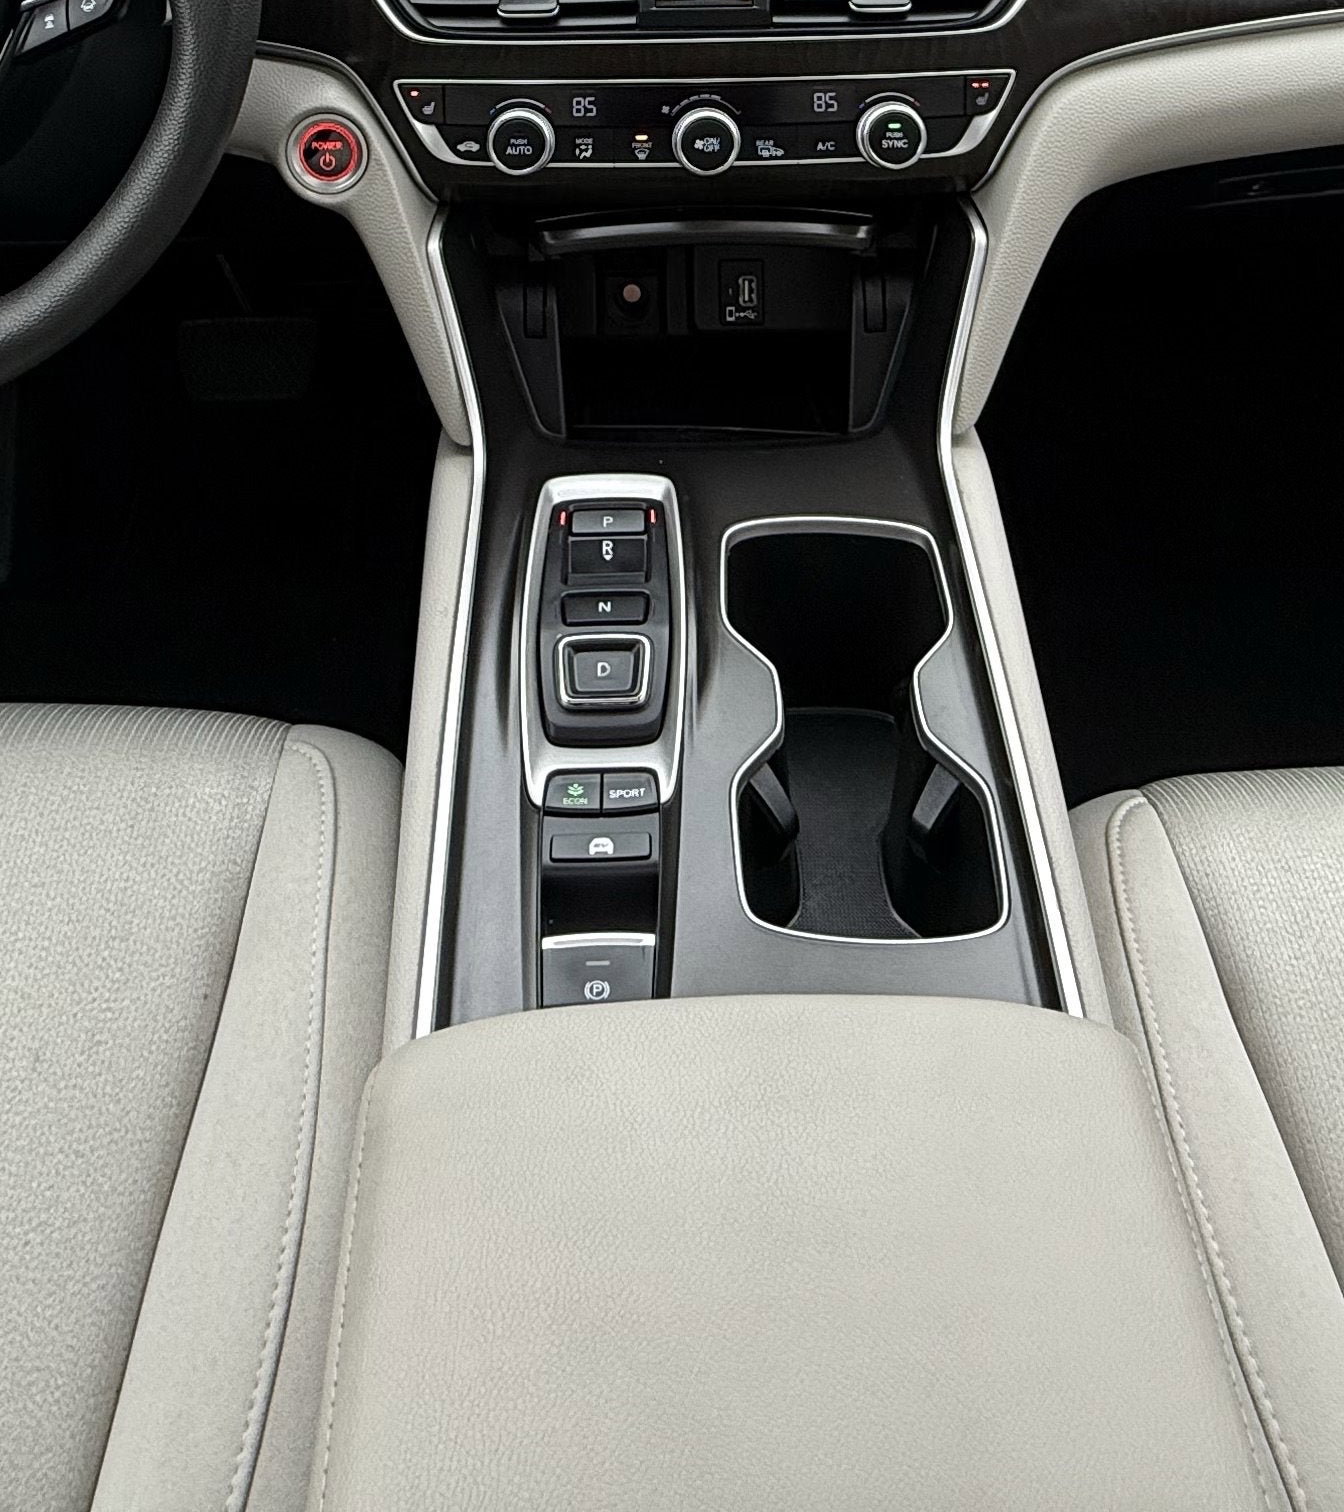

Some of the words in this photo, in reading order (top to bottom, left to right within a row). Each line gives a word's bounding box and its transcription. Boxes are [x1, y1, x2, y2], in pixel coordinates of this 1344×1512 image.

[572, 96, 597, 117] 85
[813, 92, 838, 113] 85
[816, 141, 836, 151] A/C
[881, 139, 909, 149] SYNC
[506, 146, 533, 155] AUTO
[603, 516, 614, 528] P
[602, 541, 613, 554] R
[598, 601, 612, 612] N
[597, 662, 611, 677] D
[609, 787, 646, 799] SPORT
[562, 797, 589, 805] ECON
